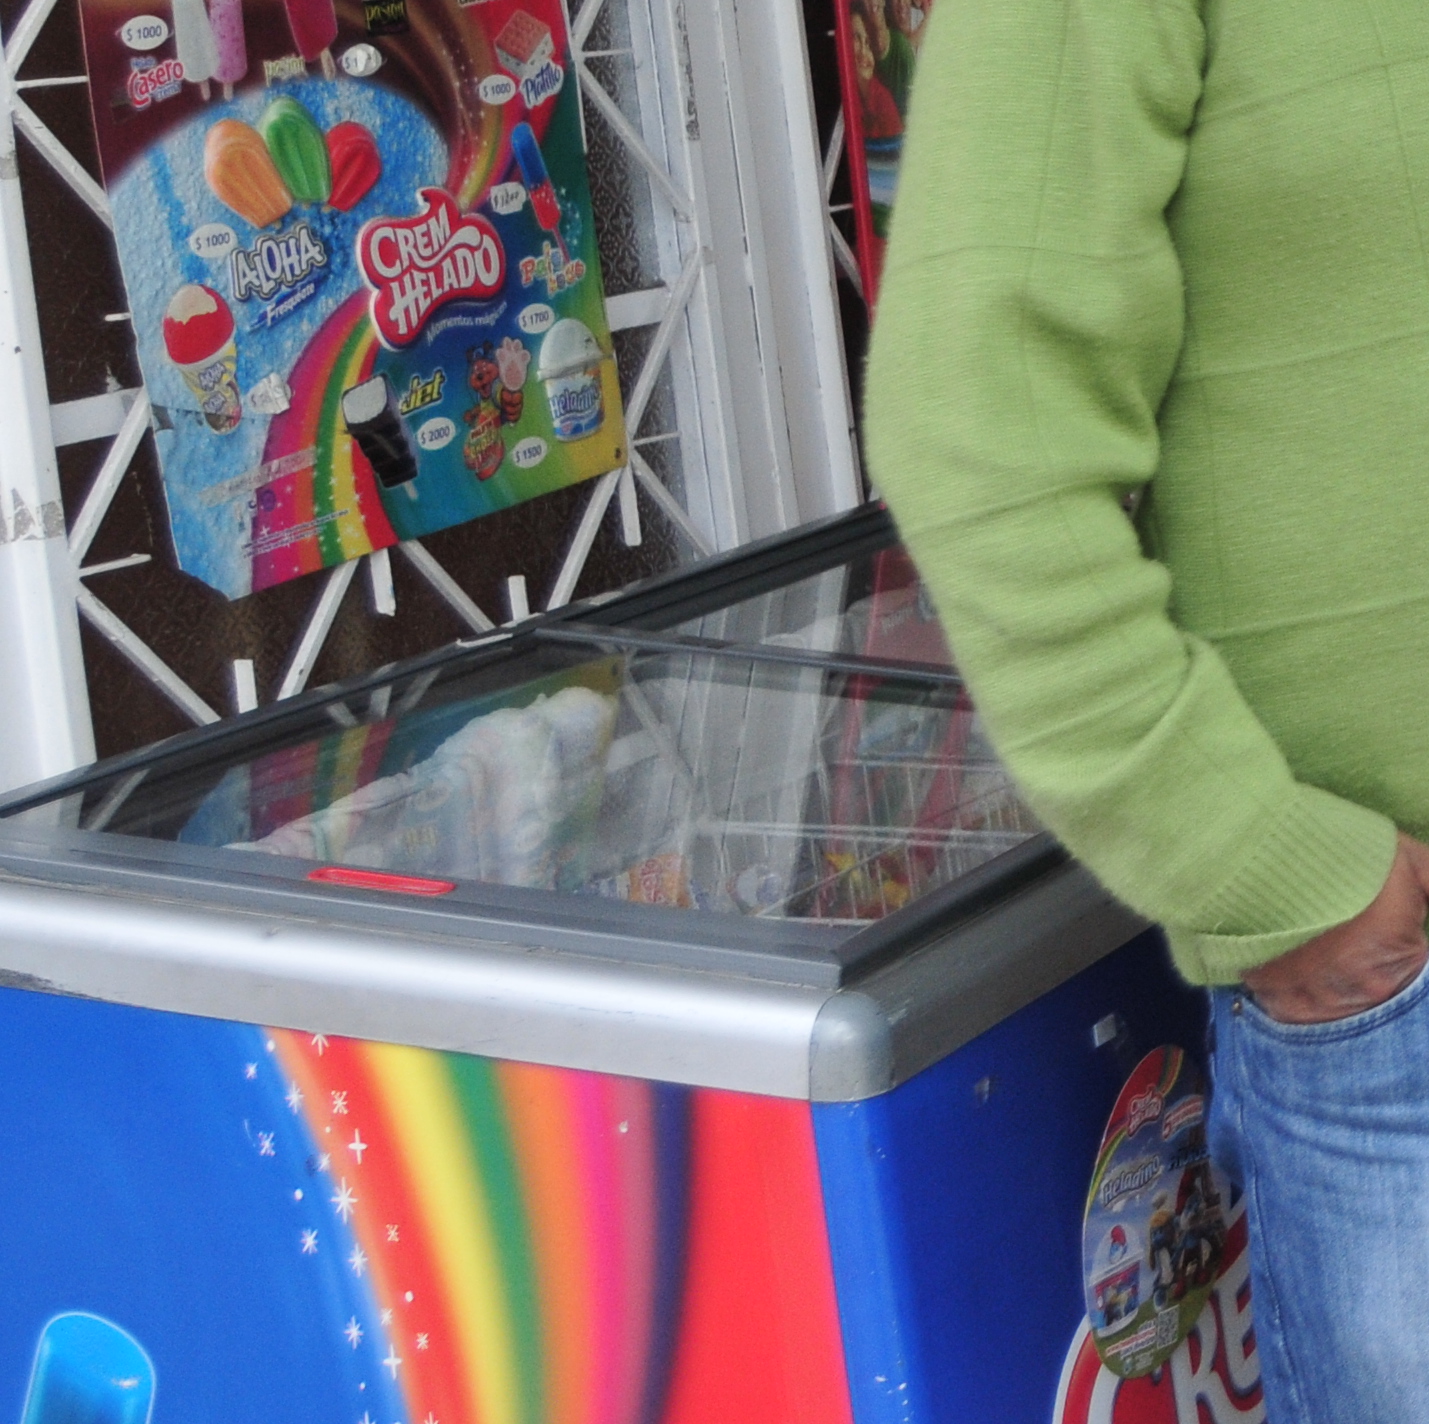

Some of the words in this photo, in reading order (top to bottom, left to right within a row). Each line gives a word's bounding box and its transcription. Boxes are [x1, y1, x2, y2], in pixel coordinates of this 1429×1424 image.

[137, 25, 162, 39] 1000
[127, 58, 185, 108] Casero
[205, 232, 231, 247] 1000
[233, 225, 325, 300] ALOHA
[370, 203, 451, 278] CREM
[389, 233, 500, 335] HELADO
[400, 368, 446, 415] Jet
[429, 426, 450, 442] 2000
